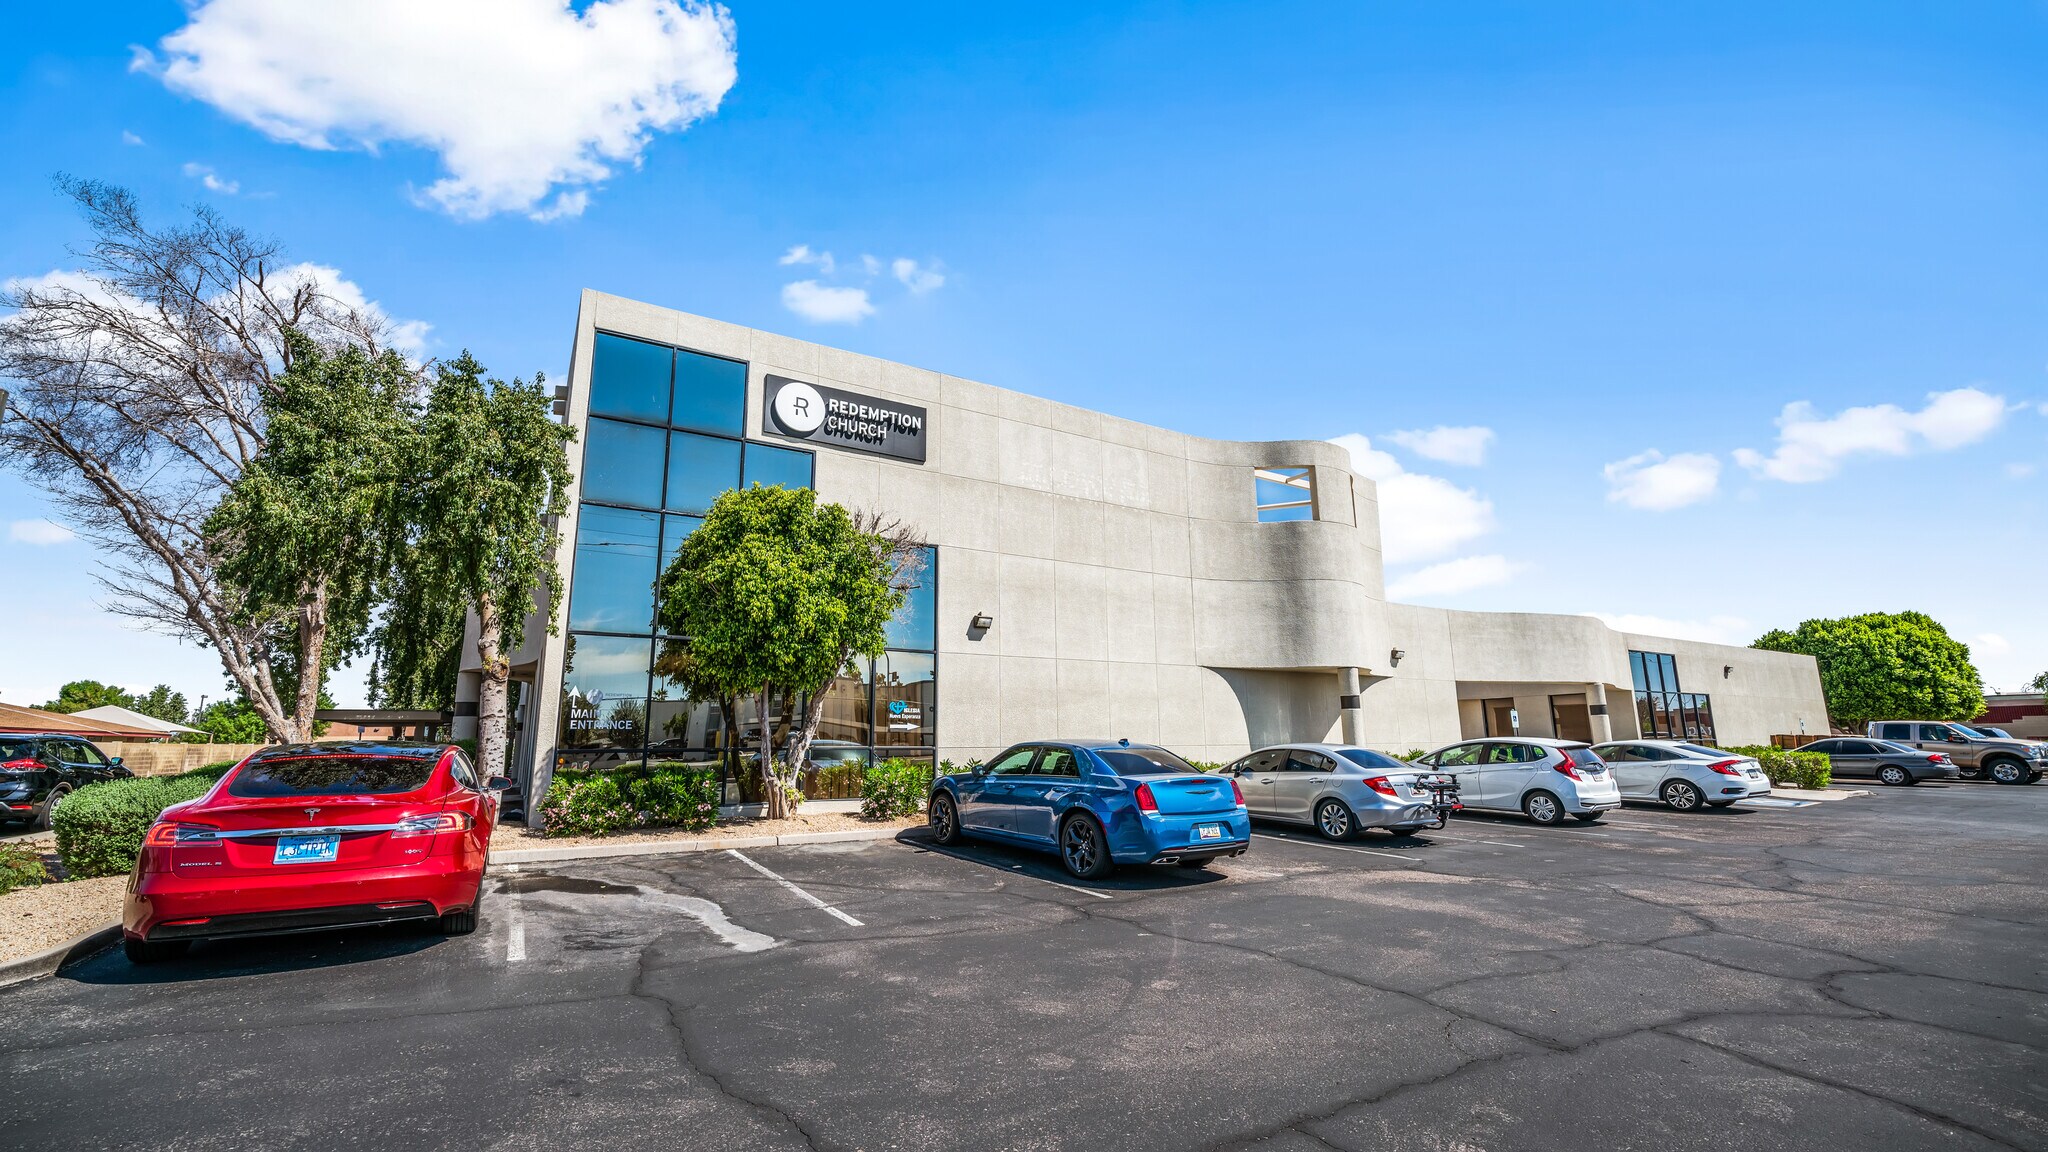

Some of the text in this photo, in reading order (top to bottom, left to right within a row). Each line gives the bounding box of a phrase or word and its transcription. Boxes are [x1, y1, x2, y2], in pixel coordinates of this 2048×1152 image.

[793, 396, 809, 418] R
[828, 398, 922, 429] REDEMPTION
[828, 416, 887, 439] CHURCH
[570, 708, 601, 719] MAIN
[570, 720, 633, 730] ENTRANCE
